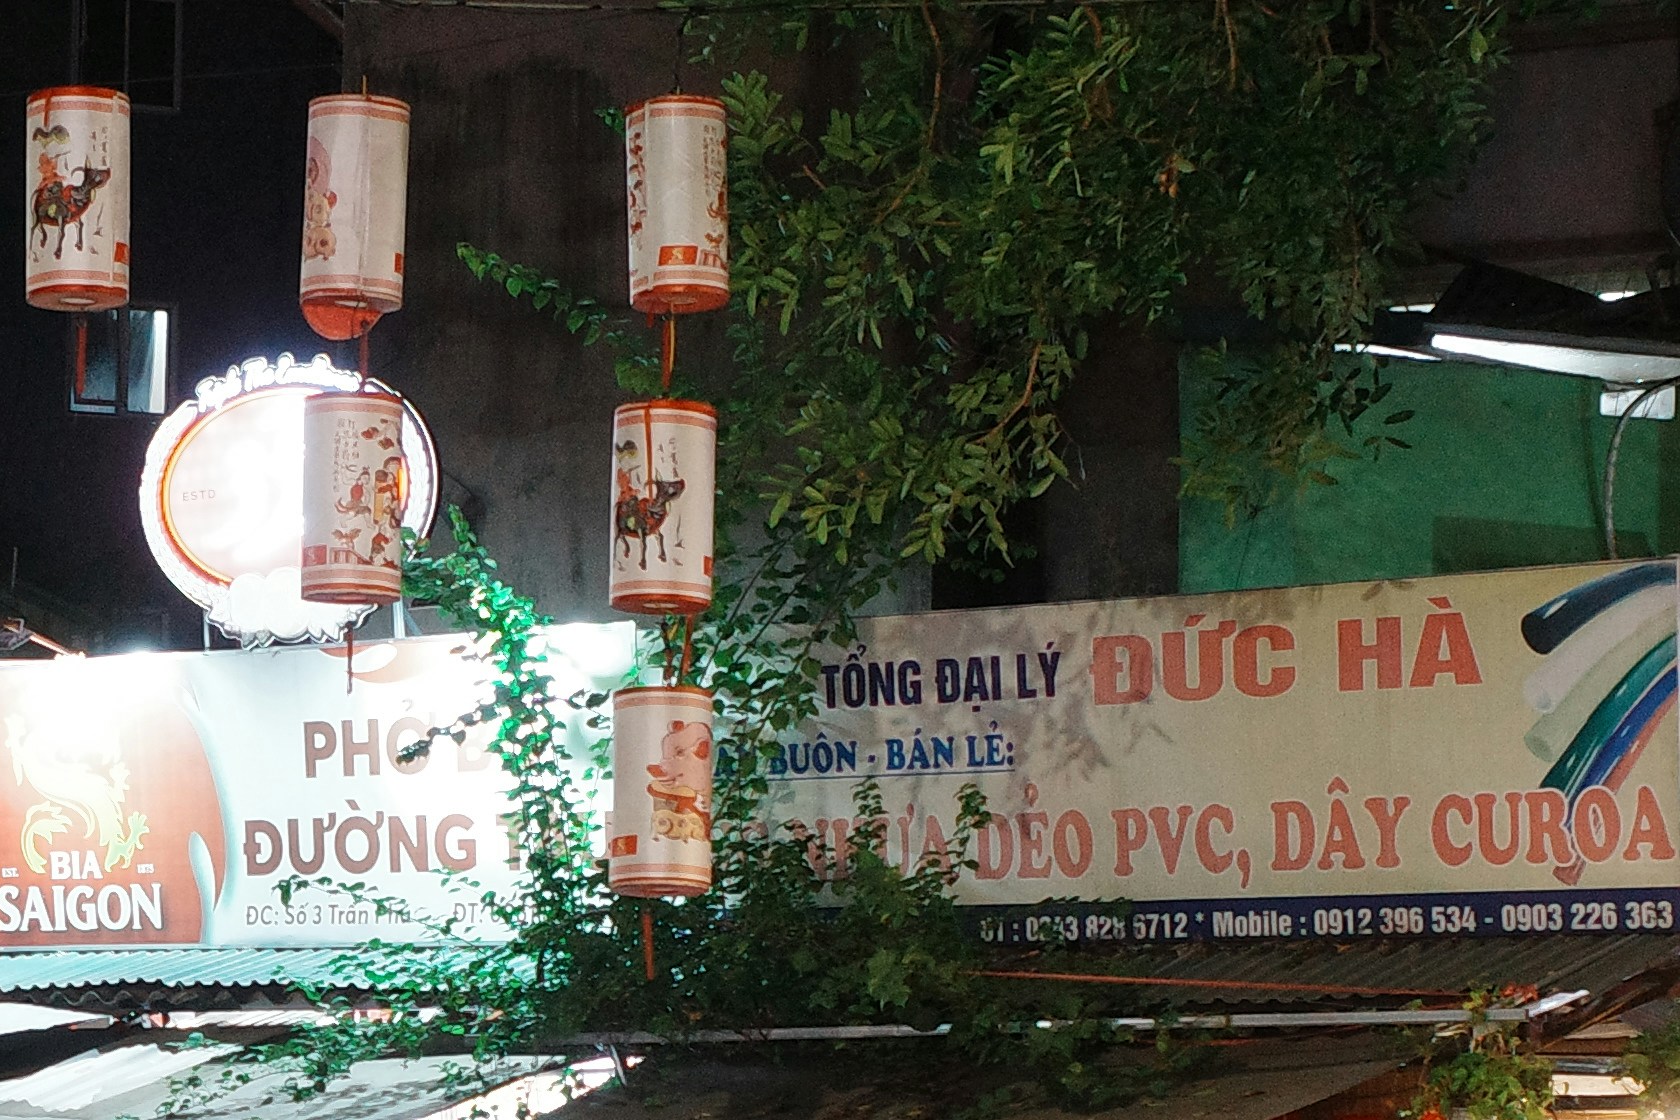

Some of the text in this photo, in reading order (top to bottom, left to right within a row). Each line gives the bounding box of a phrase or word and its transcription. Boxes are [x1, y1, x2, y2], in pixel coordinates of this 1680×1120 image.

[821, 595, 1482, 712] TỔNG ĐẠI LÝ ĐỨC HÀ
[885, 727, 955, 771] BÁN
[243, 800, 477, 876] ĐƯỜNG
[976, 783, 1090, 881] DẺO
[1113, 804, 1251, 889] PVC,
[1271, 776, 1411, 873] DÂY
[1431, 785, 1677, 867] CUROA
[50, 850, 103, 880] BIA
[313, 905, 322, 925] 3
[1132, 912, 1188, 941] 6712
[1212, 910, 1292, 938] Mobile
[1314, 908, 1373, 936] 0912
[1379, 907, 1424, 934] 396
[1431, 906, 1477, 932] 534
[1501, 904, 1564, 932] 0903
[1571, 902, 1618, 930] 226
[1625, 901, 1673, 929] 363
